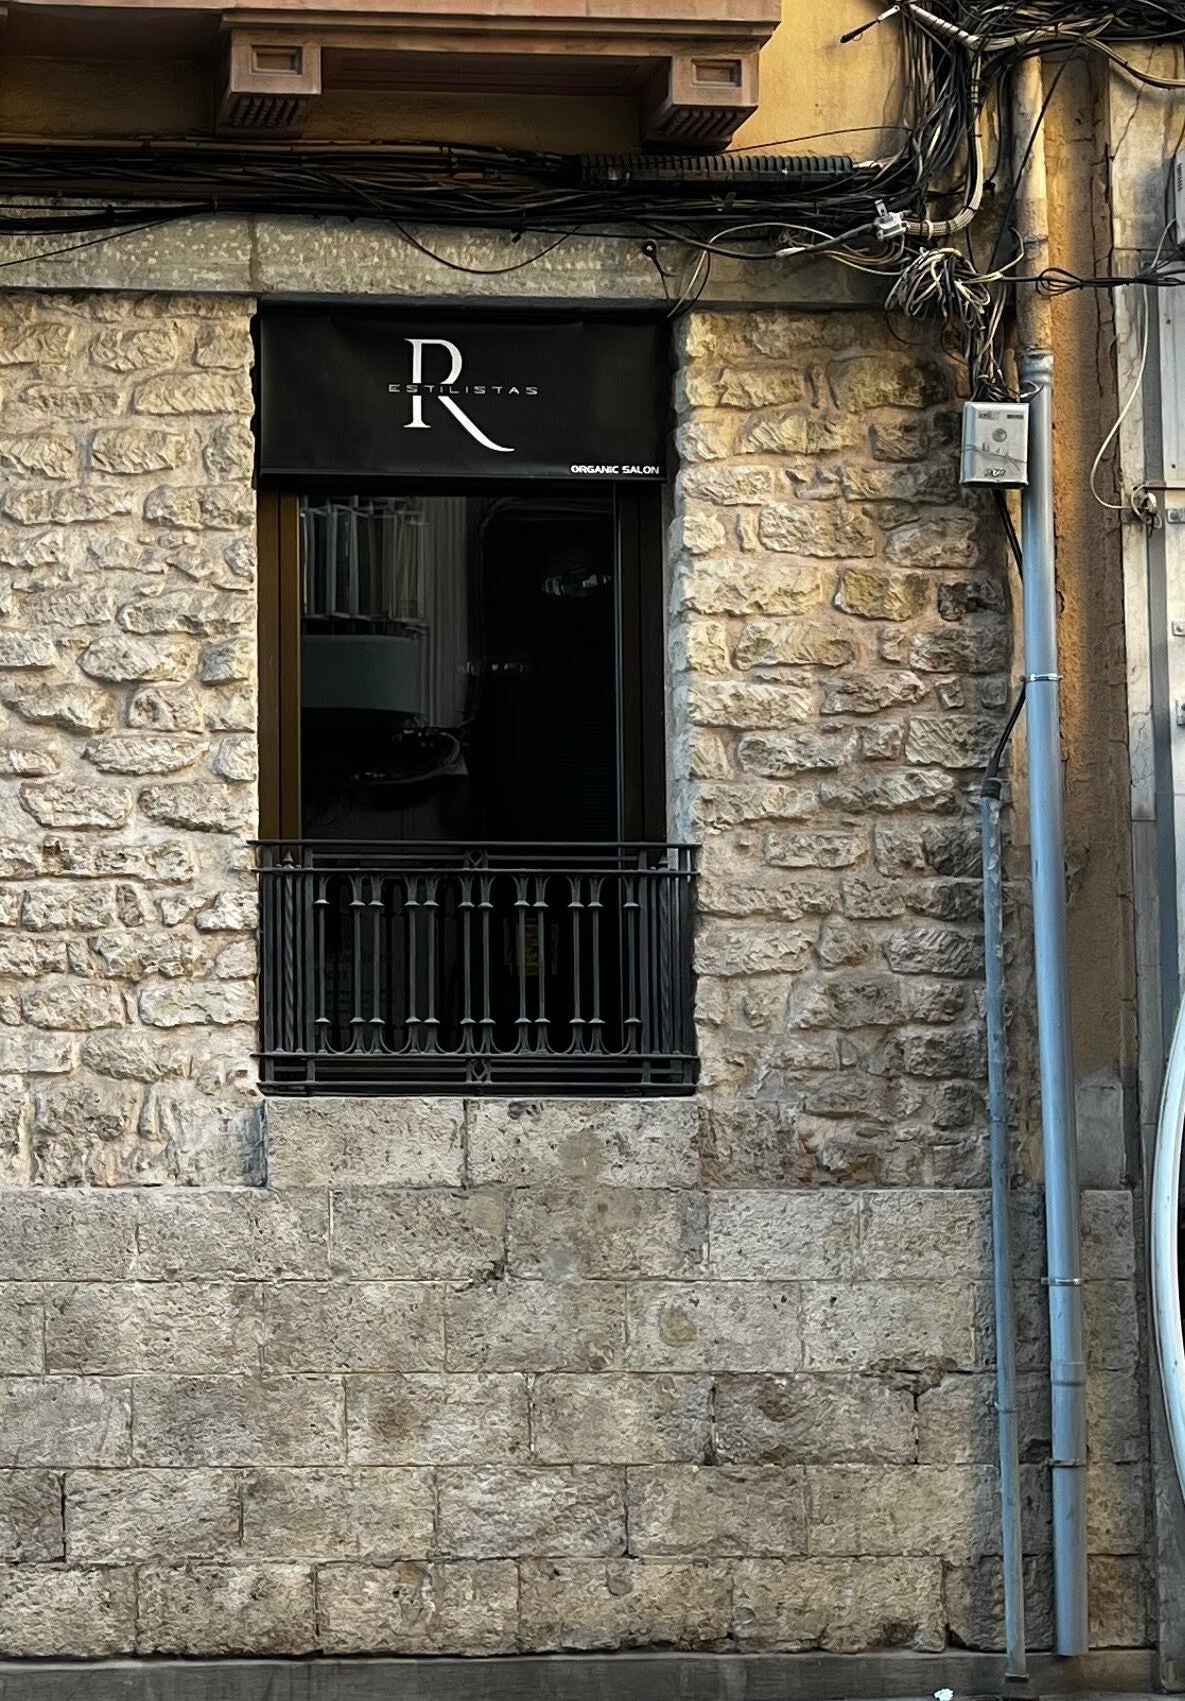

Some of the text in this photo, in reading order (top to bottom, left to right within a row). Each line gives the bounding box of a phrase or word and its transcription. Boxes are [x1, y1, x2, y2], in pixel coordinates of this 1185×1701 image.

[388, 383, 538, 396] ESTILISTAS
[403, 338, 515, 452] R
[570, 465, 660, 474] ORGANIC SALON
